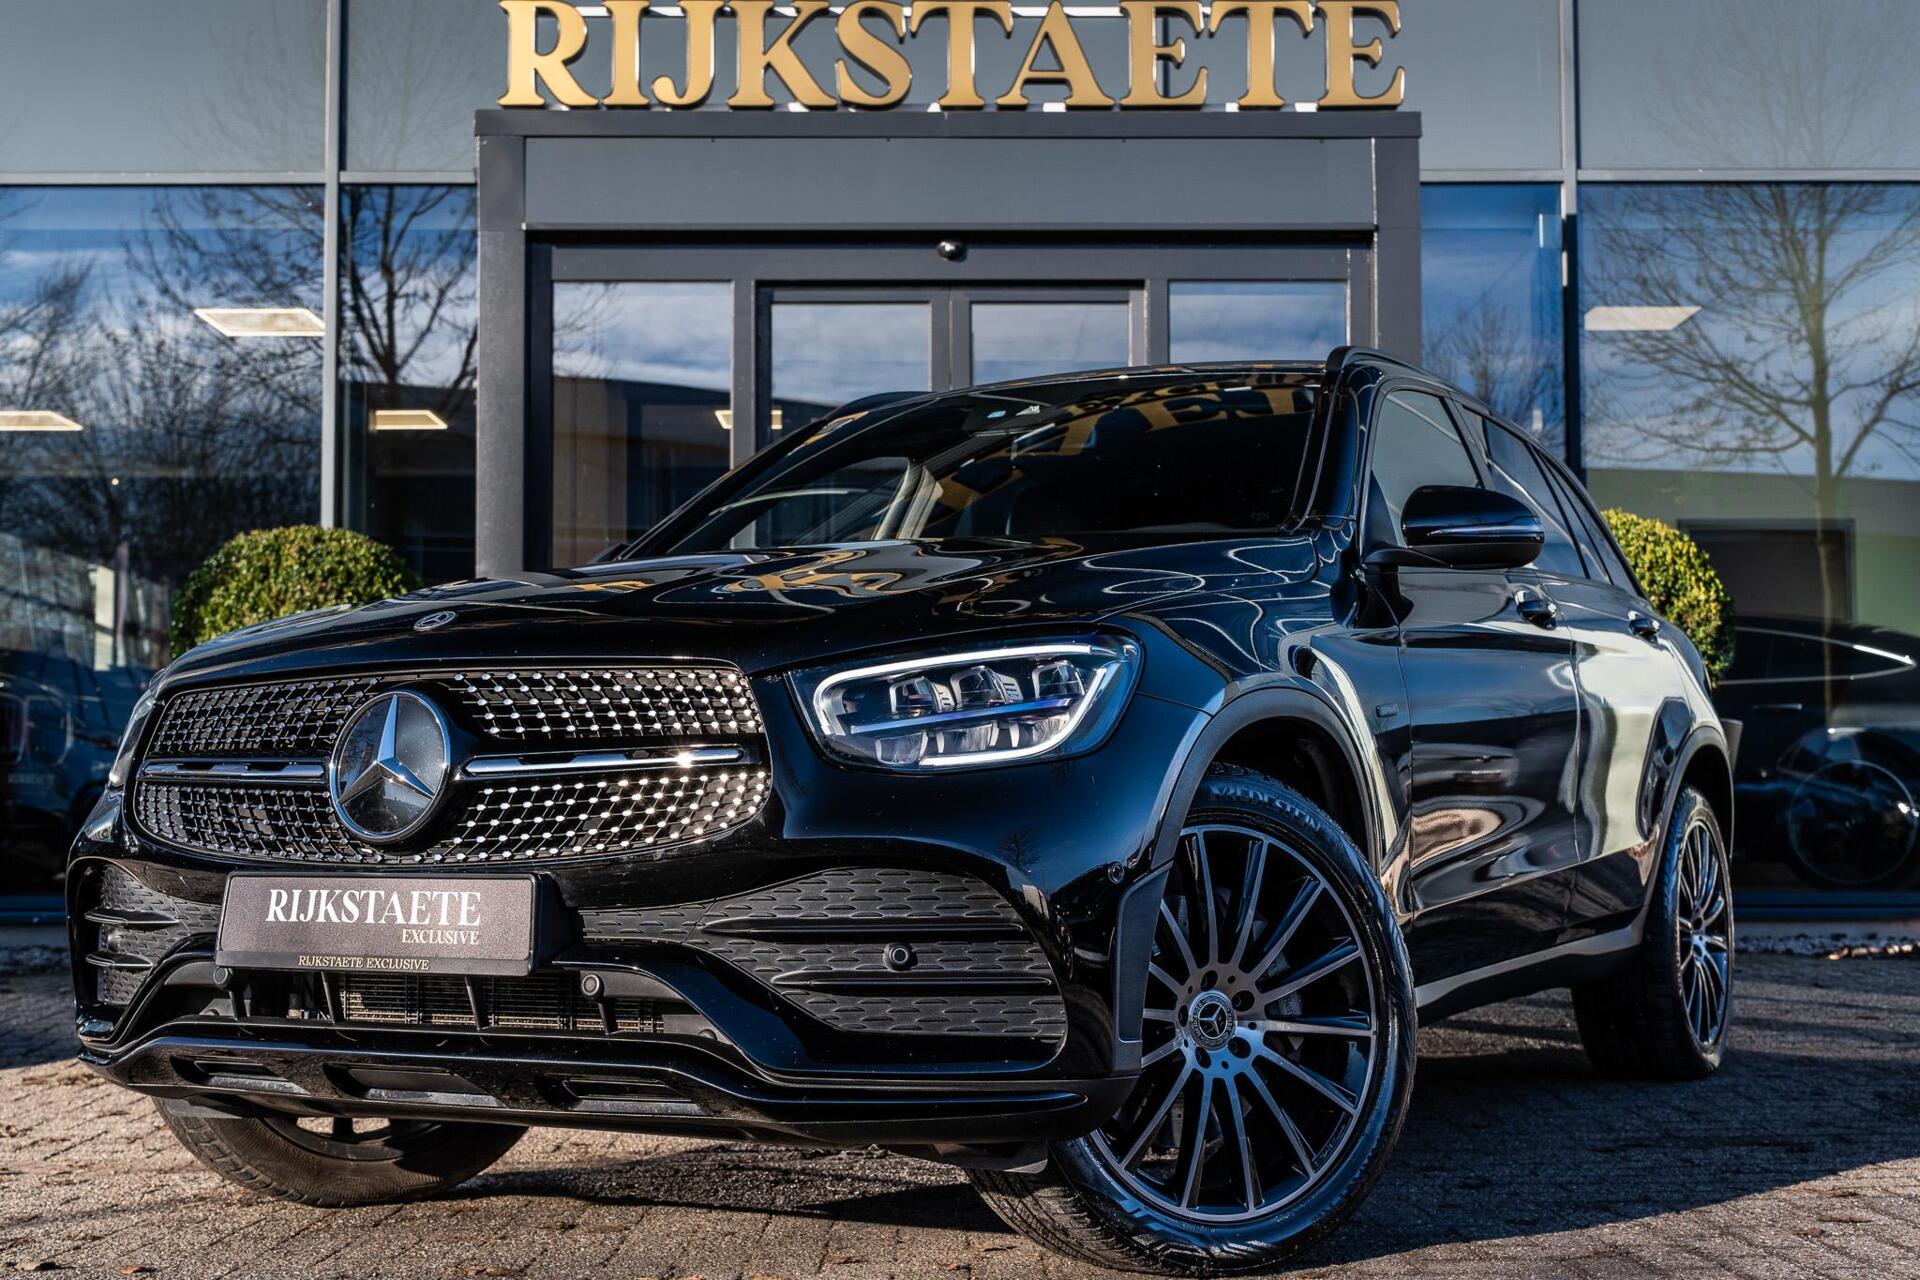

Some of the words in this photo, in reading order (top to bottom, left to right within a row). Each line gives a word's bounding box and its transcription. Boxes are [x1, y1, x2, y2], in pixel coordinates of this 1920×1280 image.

[498, 0, 1406, 108] RIJKSTAETE
[265, 889, 482, 926] RIJKSTAETE
[401, 928, 480, 945] EXCLUSIVE
[298, 955, 364, 968] RIJKSTAETE
[366, 958, 431, 971] EXCLUSIVE
